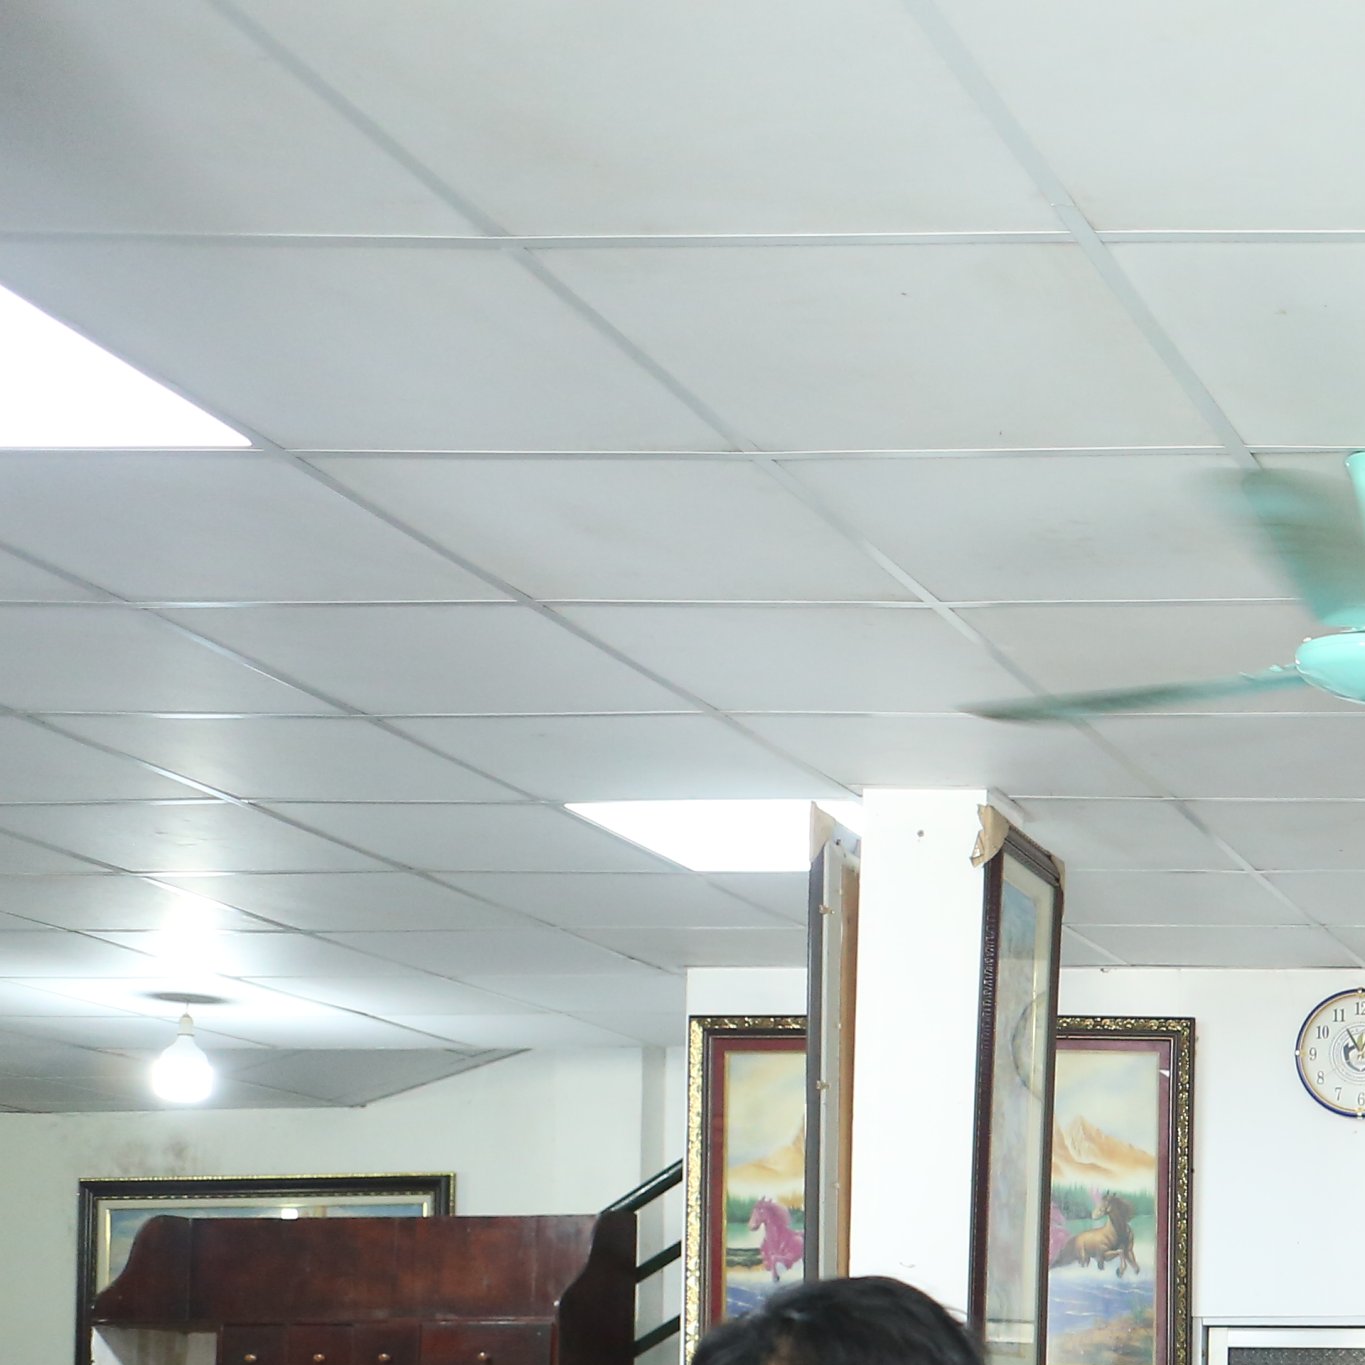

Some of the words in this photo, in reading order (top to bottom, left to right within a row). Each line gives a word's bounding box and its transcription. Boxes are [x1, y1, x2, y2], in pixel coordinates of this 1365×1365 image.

[1333, 1008, 1345, 1022] 11
[1316, 1025, 1329, 1039] 10
[1309, 1047, 1317, 1061] 9
[1317, 1071, 1325, 1085] 8
[1334, 1087, 1342, 1101] 7
[1357, 1092, 1365, 1106] 6
